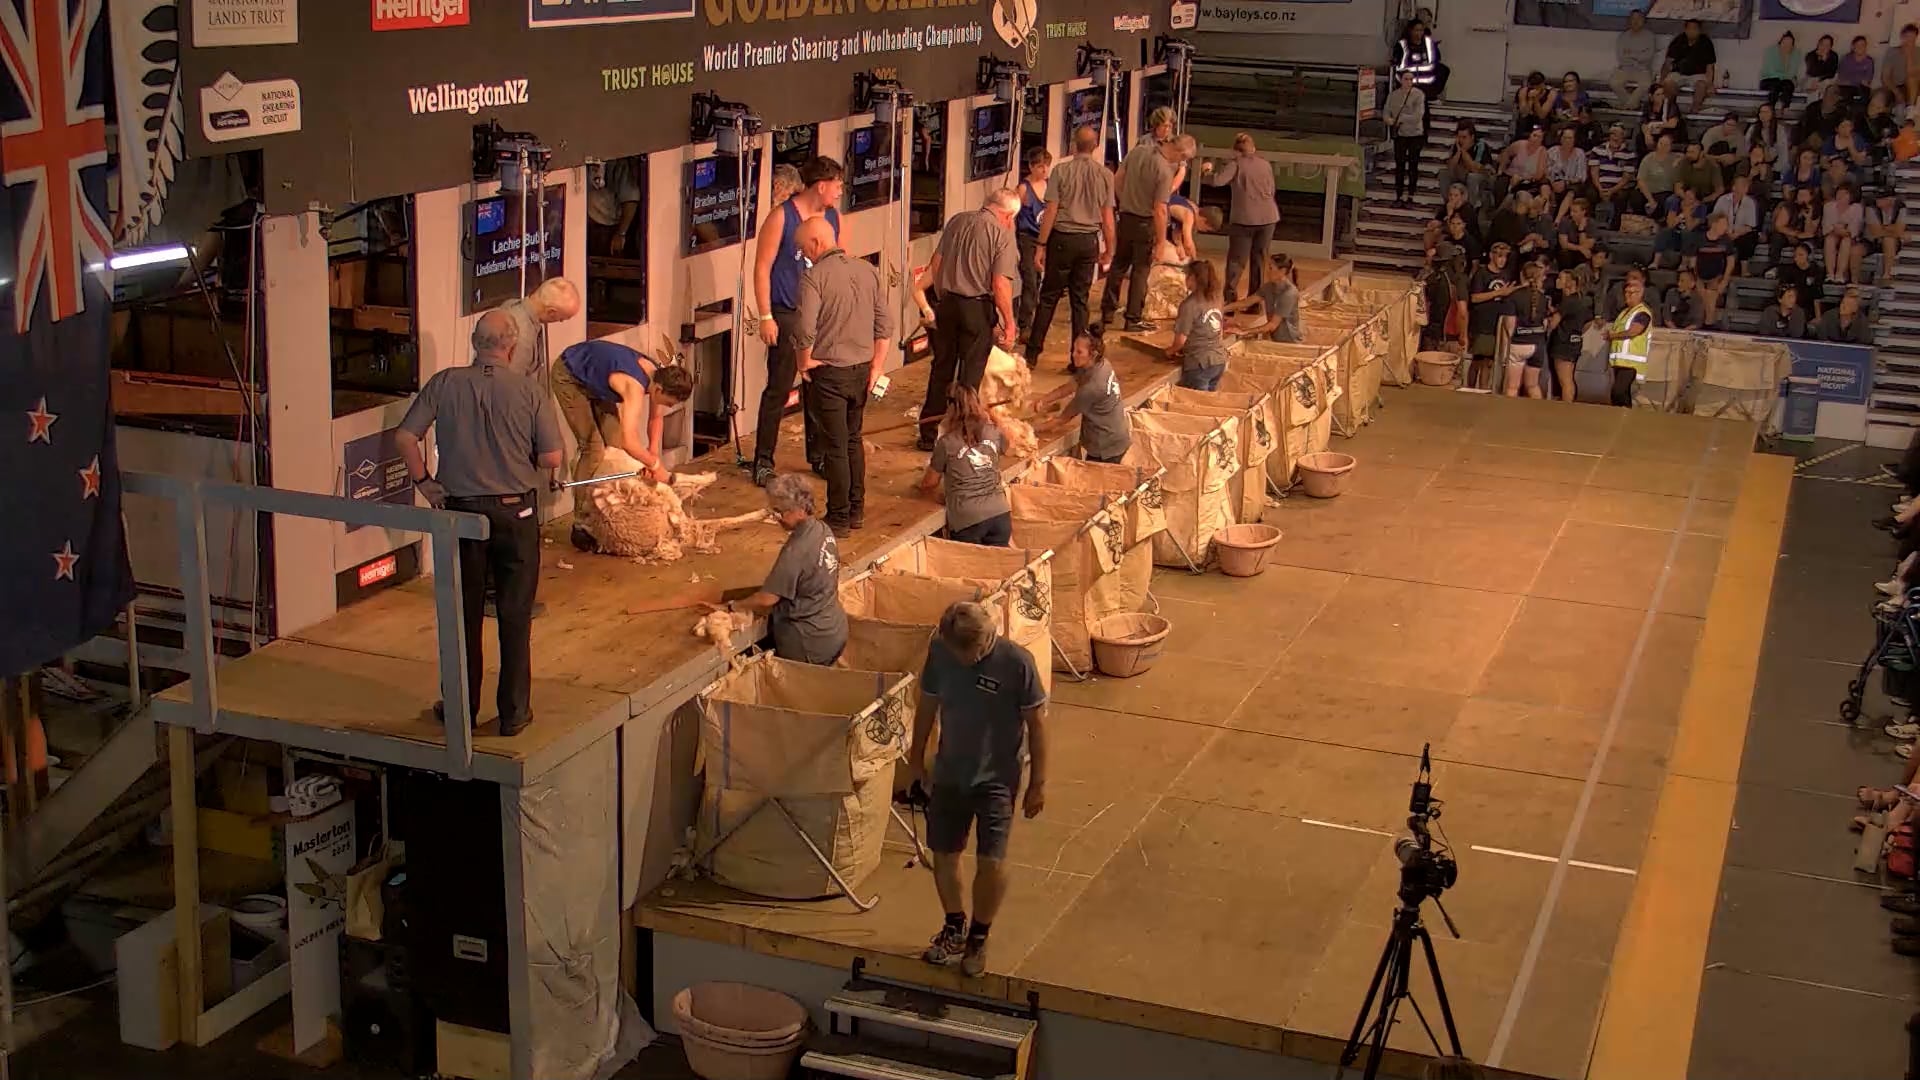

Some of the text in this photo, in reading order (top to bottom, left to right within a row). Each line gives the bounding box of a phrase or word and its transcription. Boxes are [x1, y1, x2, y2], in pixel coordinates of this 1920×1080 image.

[208, 9, 285, 25] LANDS TRUST
[703, 20, 982, 72] World Premier Shearing and Woolhandling Championship
[602, 65, 647, 91] TRUST
[261, 88, 295, 100] NATIONAL
[408, 78, 529, 114] WellingtonNZ
[262, 113, 288, 125] CIRCUIT
[293, 820, 351, 858] Masterton
